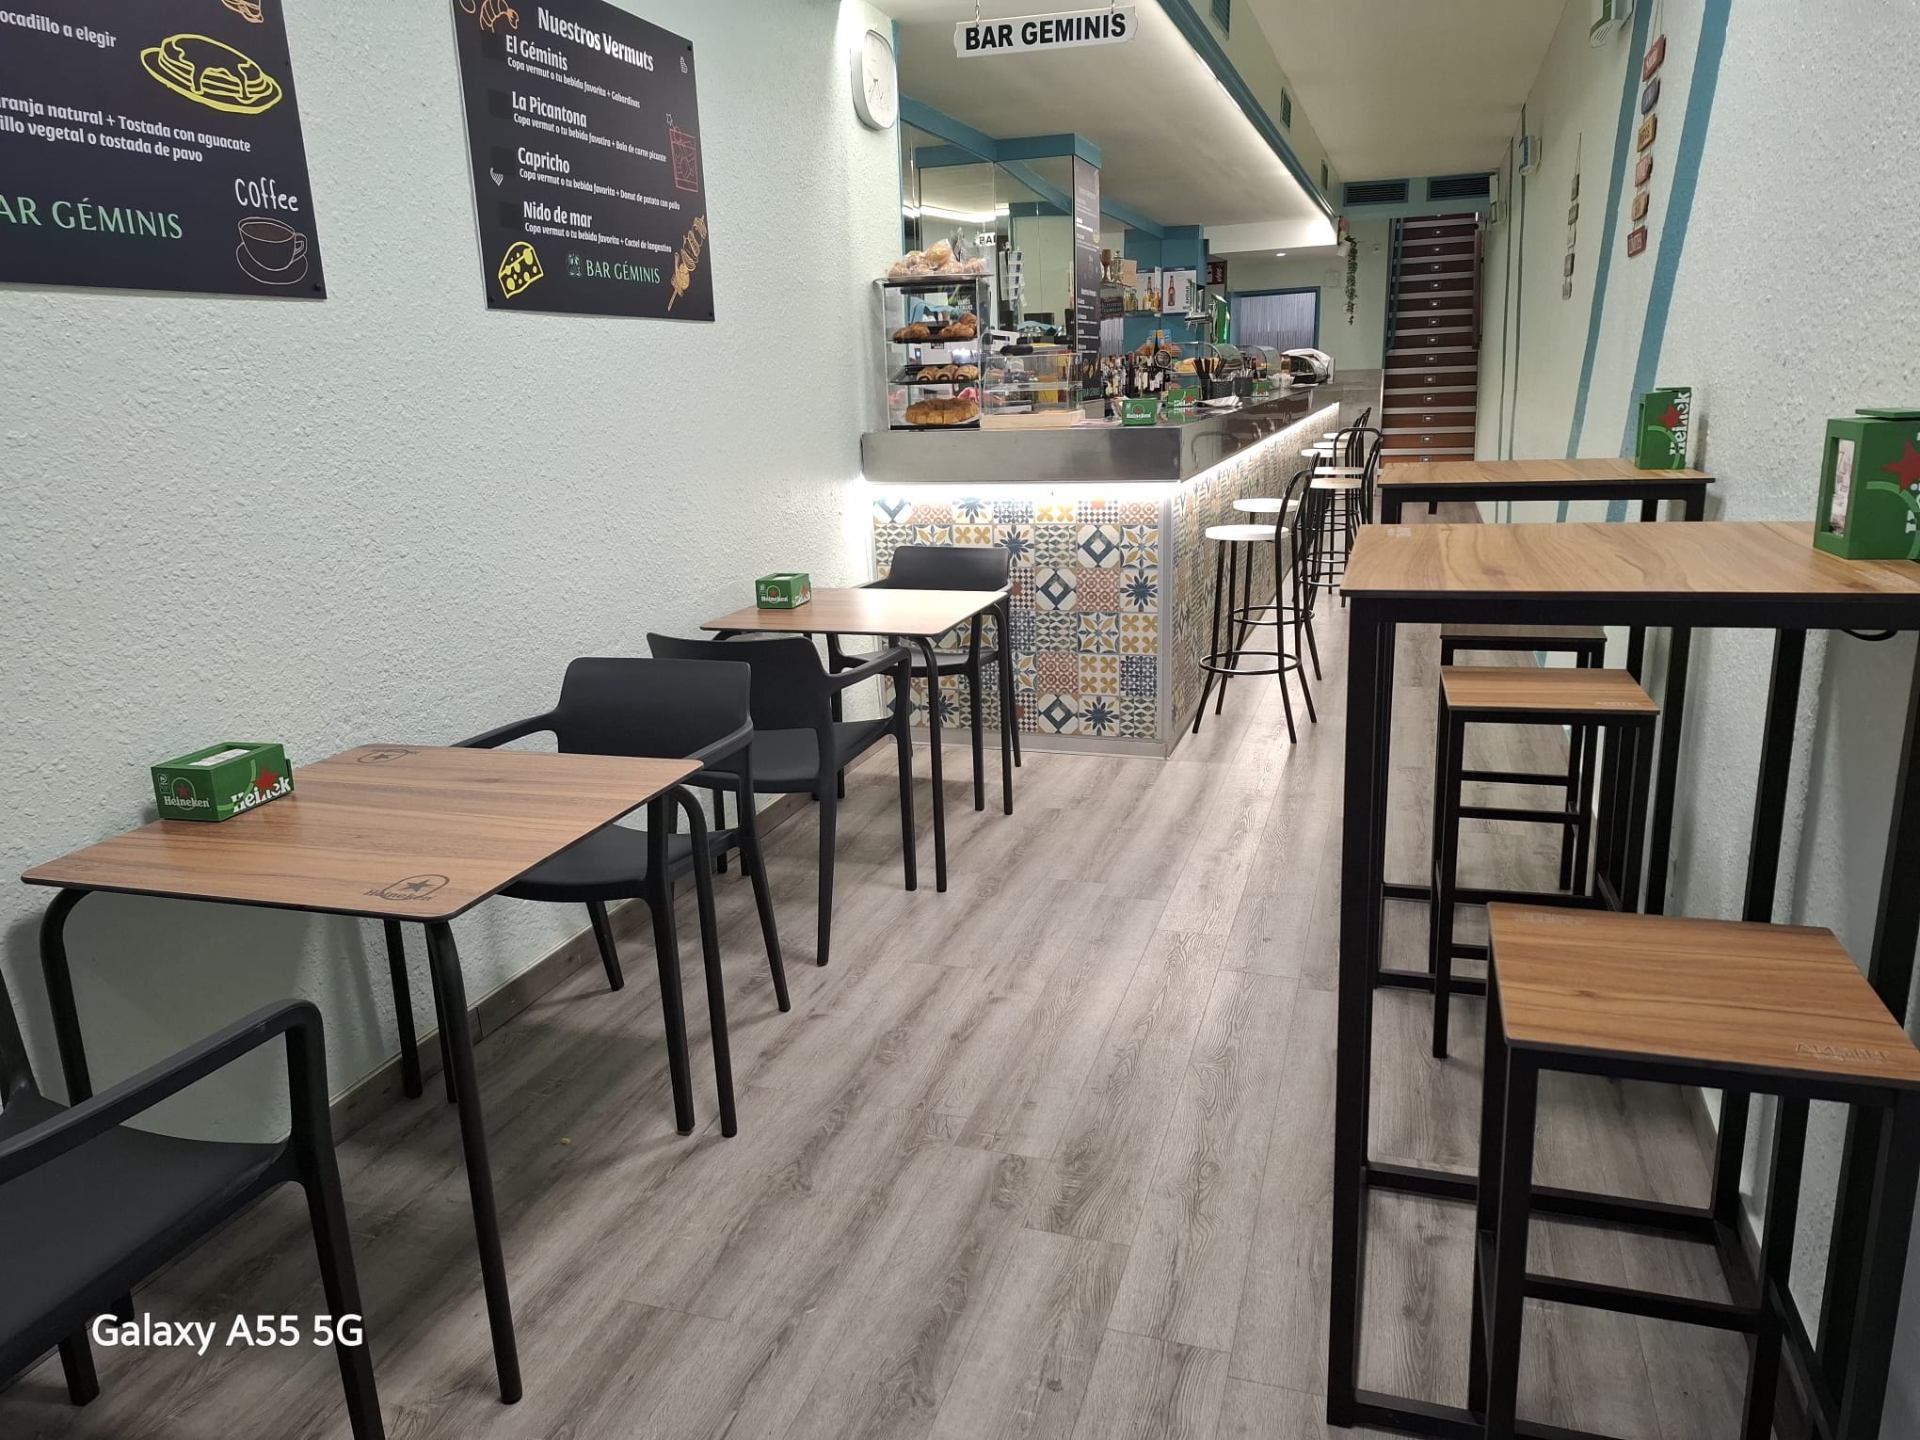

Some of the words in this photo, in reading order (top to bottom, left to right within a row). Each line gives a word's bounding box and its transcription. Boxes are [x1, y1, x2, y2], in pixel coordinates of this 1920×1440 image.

[0, 10, 60, 34] ocadillo
[63, 25, 73, 37] a
[76, 26, 116, 48] elegir
[537, 6, 601, 51] Nuestros
[602, 32, 654, 72] Vermuts
[965, 24, 1014, 50] BAR
[1021, 13, 1126, 45] GEMINIS
[505, 34, 517, 55] El
[520, 40, 568, 71] Géminis
[507, 57, 524, 71] Copa
[526, 63, 550, 79] vermut
[550, 72, 555, 80] o
[555, 73, 563, 83] tu
[563, 75, 583, 90] bebida
[611, 91, 640, 109] Gabardinas
[512, 91, 526, 111] La
[529, 95, 587, 128] Picantona
[27, 122, 85, 142] vegetal
[87, 133, 97, 145] o
[100, 133, 152, 154] tostada
[154, 141, 170, 157] de
[172, 147, 203, 162] pavo
[47, 105, 103, 126] natural
[106, 114, 116, 126] +
[118, 115, 171, 138] Tostada
[173, 128, 195, 142] con
[197, 132, 251, 152] aguacate
[513, 113, 531, 127] Copa
[532, 119, 555, 132] vermut
[555, 125, 560, 133] o
[560, 126, 568, 135] tu
[568, 127, 588, 141] bebida
[628, 144, 634, 153] de
[635, 147, 648, 157] carne
[518, 147, 570, 174] Capricho
[519, 168, 536, 181] Copa
[537, 173, 560, 185] vermut
[560, 178, 565, 186] o
[565, 178, 573, 188] tu
[573, 178, 593, 192] bebida
[636, 193, 642, 202] de
[52, 197, 183, 239] GÉMINIS
[523, 201, 551, 222] Nido
[553, 206, 568, 224] de
[570, 212, 592, 228] mar
[525, 222, 541, 235] Copa
[542, 226, 565, 237] vermut
[570, 230, 577, 238] tu
[578, 230, 597, 242] bebida
[640, 240, 646, 249] de
[586, 259, 611, 279] BAR
[614, 260, 661, 284] GÉMINIS
[164, 796, 211, 808] Heineken
